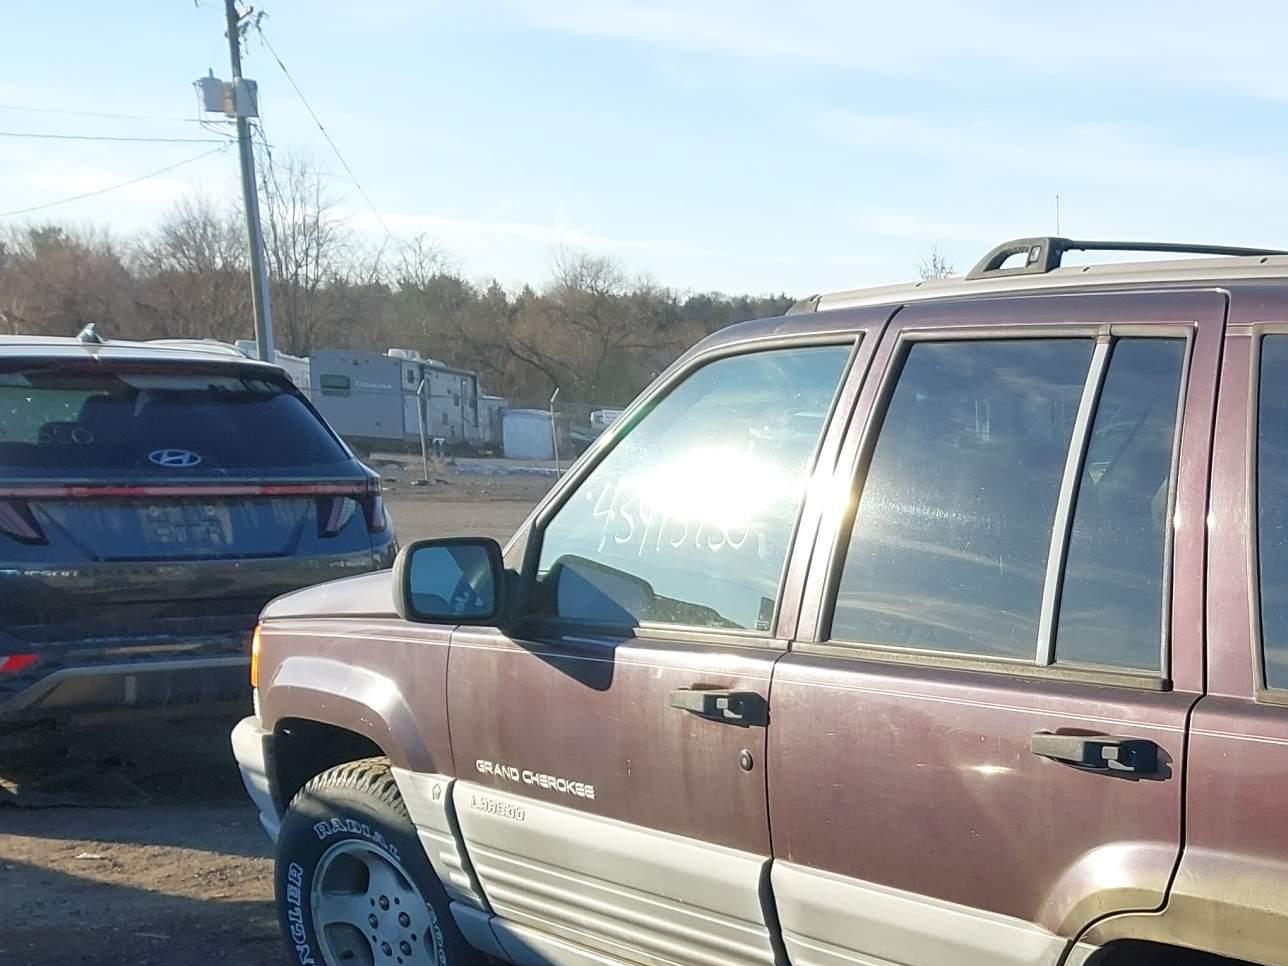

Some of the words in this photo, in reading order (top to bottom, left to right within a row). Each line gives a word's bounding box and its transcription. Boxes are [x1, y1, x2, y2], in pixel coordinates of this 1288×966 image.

[475, 759, 520, 782] GRAND
[522, 769, 596, 800] CHEROKEE
[313, 817, 401, 860] RADIAL
